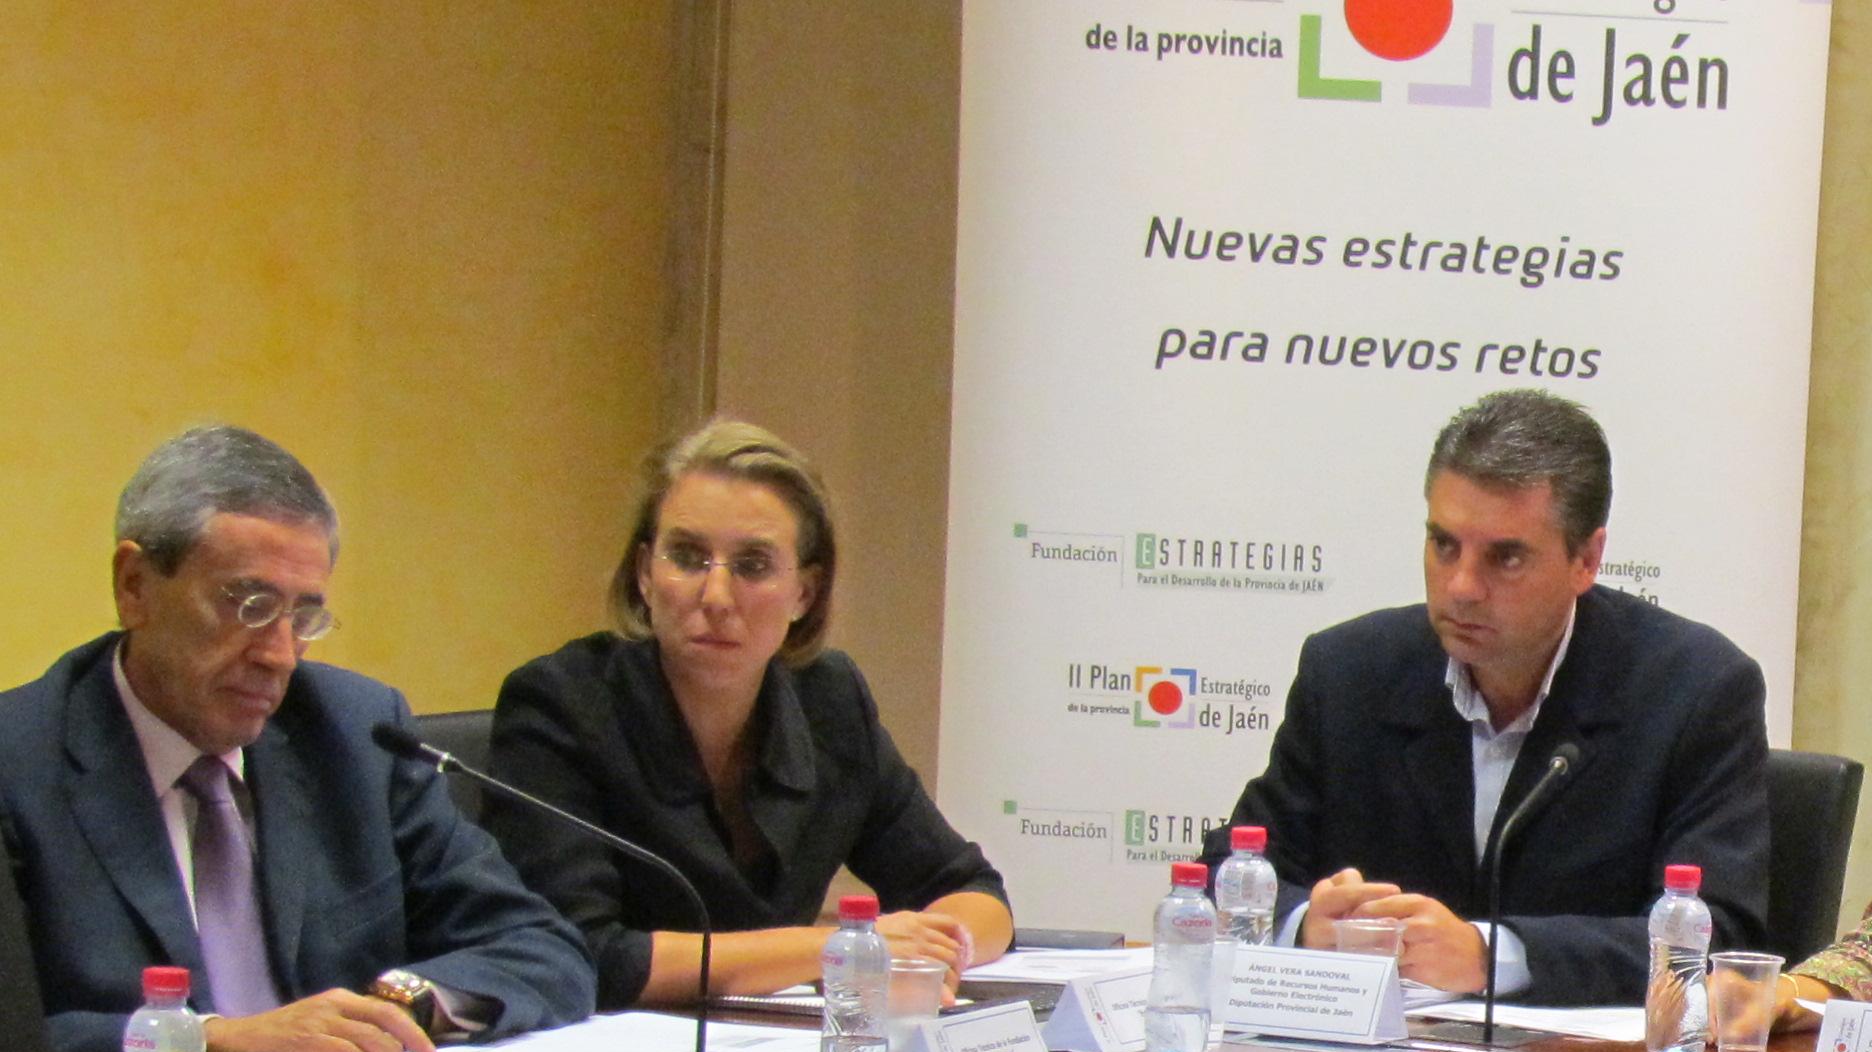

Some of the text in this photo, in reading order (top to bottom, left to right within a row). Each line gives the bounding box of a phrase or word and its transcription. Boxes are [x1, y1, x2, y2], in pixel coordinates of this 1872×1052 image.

[1085, 23, 1284, 61] de la provincia
[1507, 24, 1729, 127] de Jaén
[1144, 216, 1624, 289] Nuevas estrategias
[1155, 327, 1602, 380] para nuevos retos
[1031, 541, 1118, 563] Fundación
[1141, 536, 1323, 573] ESTRATEGIAS
[1598, 560, 1661, 582] stratégico
[1137, 572, 1324, 593] Para el Desarrollo de la Provincia de JAÉN
[1068, 663, 1131, 691] II Plan
[1200, 677, 1271, 701] Estratégico
[1067, 703, 1130, 716] de la provincia
[1199, 703, 1270, 734] de Jaén
[1021, 818, 1107, 839] Fundación
[1127, 849, 1147, 861] Para
[1151, 850, 1158, 861] el
[1280, 967, 1302, 977] VERA
[1304, 969, 1351, 981] SANDOVAL
[1232, 976, 1368, 996] iputado de Recursos Humanos y
[1250, 987, 1289, 999] Gobierno
[1229, 998, 1353, 1017] Diputación Provincial de Jaén
